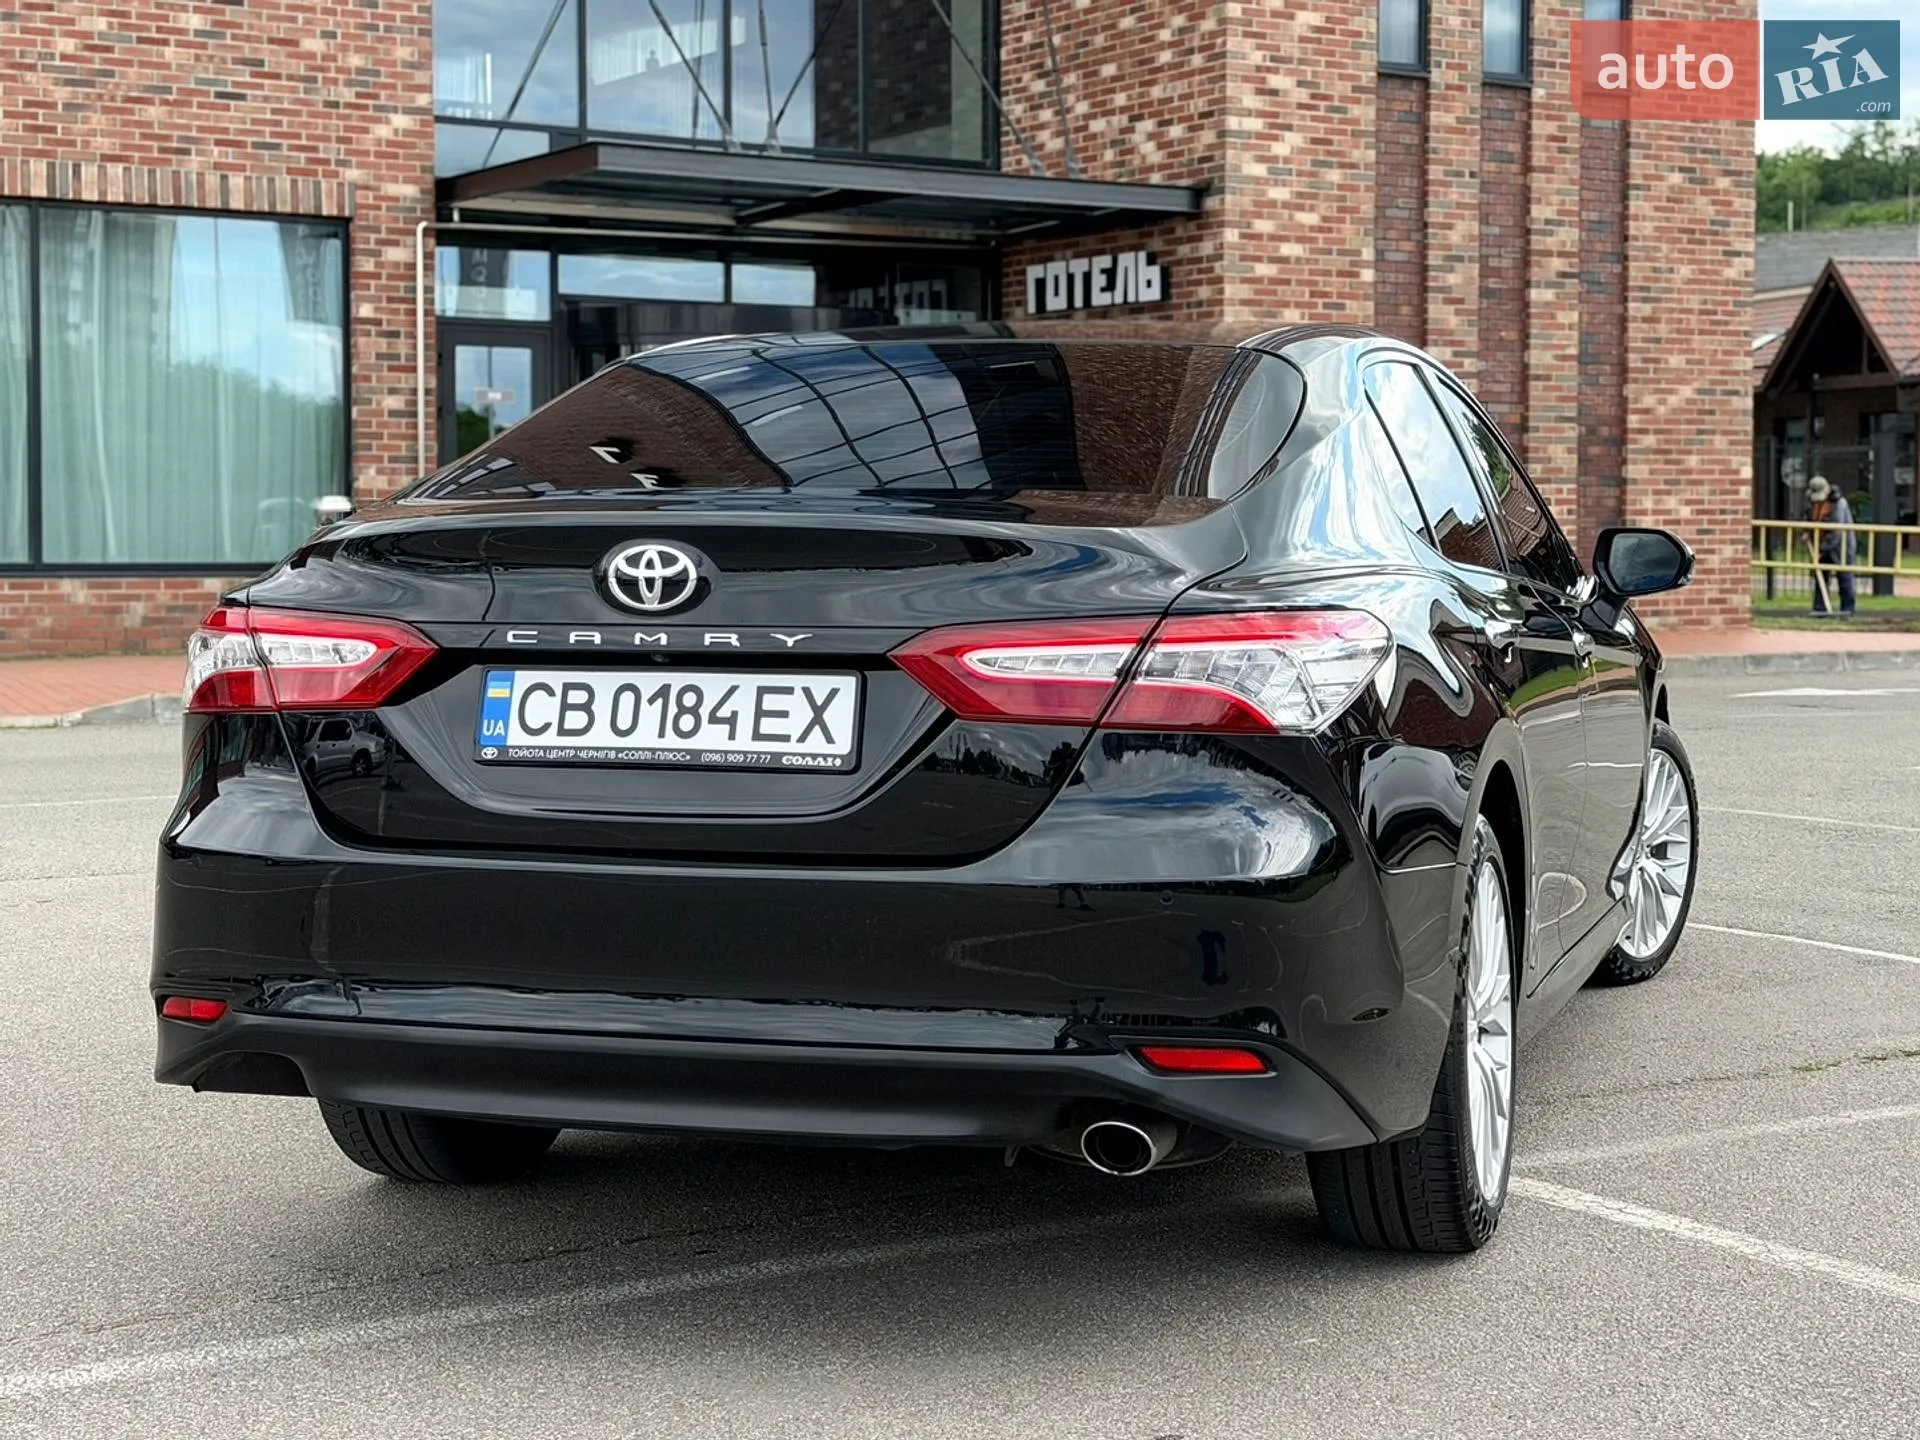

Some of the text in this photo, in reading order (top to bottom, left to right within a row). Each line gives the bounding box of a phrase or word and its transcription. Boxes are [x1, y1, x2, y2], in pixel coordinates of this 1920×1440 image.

[1026, 250, 1162, 315] ГОТЕЛЬ
[506, 630, 813, 648] CAMRY
[483, 719, 506, 737] UA
[508, 748, 544, 758] ТОЙОТА
[546, 749, 576, 759] ЦЕНТР
[701, 752, 725, 764] (096)
[727, 753, 744, 763] 909
[746, 754, 758, 764] 77
[759, 754, 772, 764] 77
